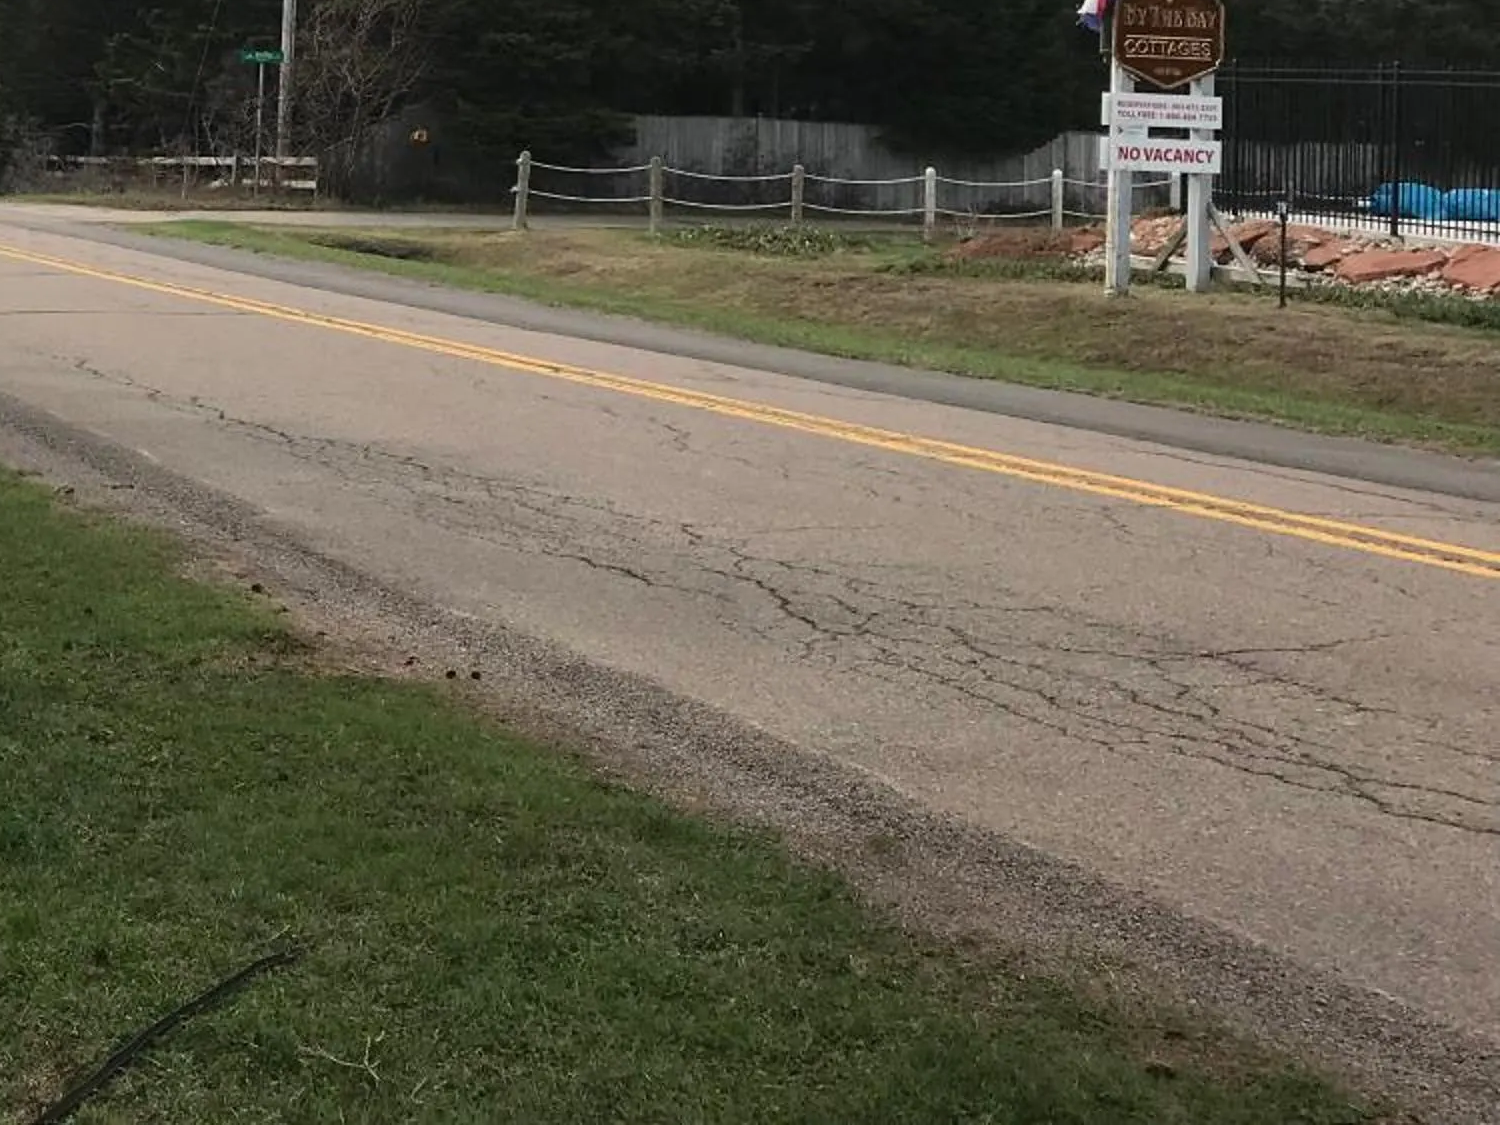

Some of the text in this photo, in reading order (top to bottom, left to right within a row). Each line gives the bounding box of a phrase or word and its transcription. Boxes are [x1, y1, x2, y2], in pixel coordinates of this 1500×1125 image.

[1124, 38, 1212, 56] COTTAGES
[1118, 146, 1215, 164] NO VACANCY
